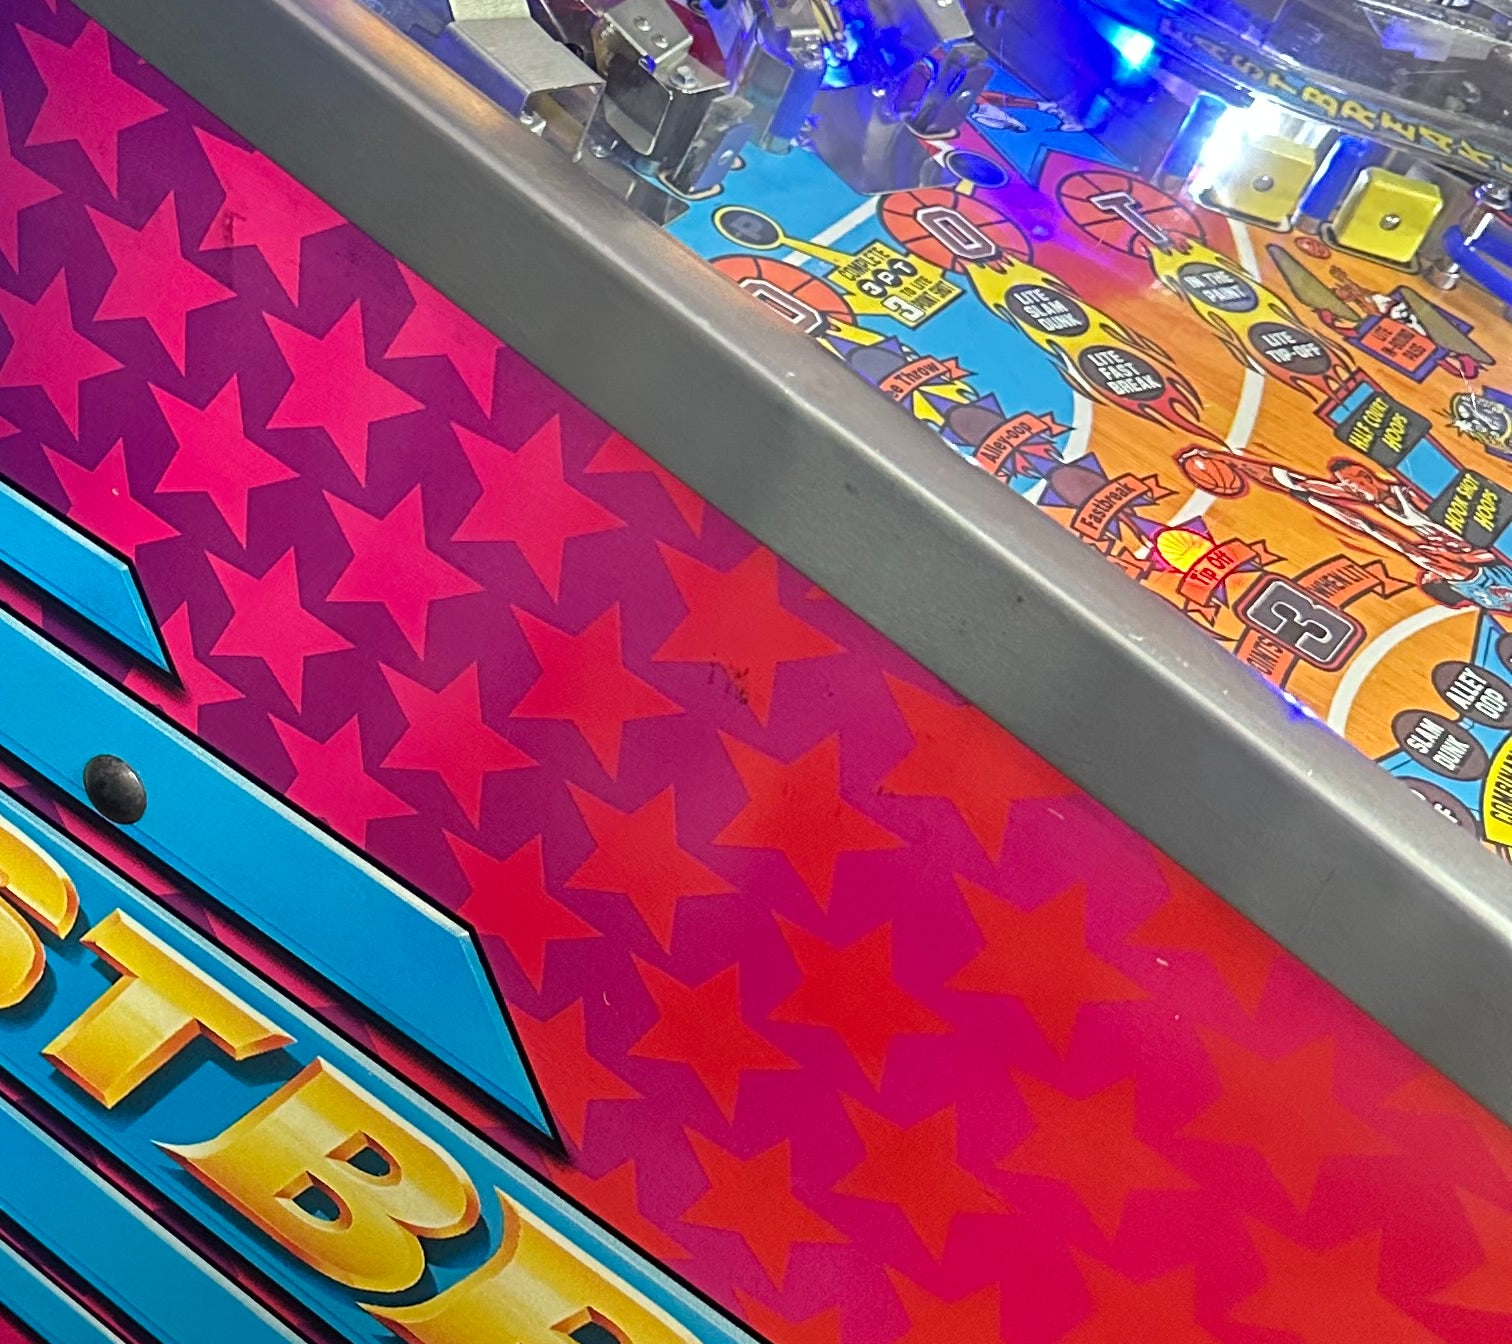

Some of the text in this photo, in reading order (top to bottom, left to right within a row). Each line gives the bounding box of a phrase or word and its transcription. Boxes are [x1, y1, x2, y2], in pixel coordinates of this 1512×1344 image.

[1091, 192, 1174, 248] T
[838, 247, 890, 281] COMPLETE
[1183, 269, 1236, 289] IN THE
[899, 274, 933, 298] TO LITE
[1013, 287, 1051, 306] LITE
[1201, 284, 1248, 304] PAINT
[1022, 299, 1071, 320] SLAM
[1037, 312, 1085, 333] DUNK
[1260, 330, 1297, 348] LITE
[1264, 342, 1322, 364] TIP-OFF
[894, 360, 941, 387] Throw
[1087, 348, 1126, 367] LITE
[1097, 361, 1142, 382] FAST
[1106, 373, 1163, 397] BREAK
[980, 420, 1034, 464] Alley-oop
[1348, 396, 1389, 454] HALF COURT
[1381, 412, 1409, 454] HOOPS
[1080, 480, 1137, 531] Fastbreak
[1444, 472, 1481, 536] HOOK SHOT
[1473, 488, 1499, 533] HOOPS
[1190, 549, 1235, 586] Tip Off
[1246, 580, 1355, 663] 3
[1245, 635, 1284, 676] OINTS
[1445, 667, 1488, 710] ALLEY
[1474, 686, 1509, 721] OOP
[1406, 717, 1446, 755] SLAM
[1433, 734, 1471, 772] DUNK
